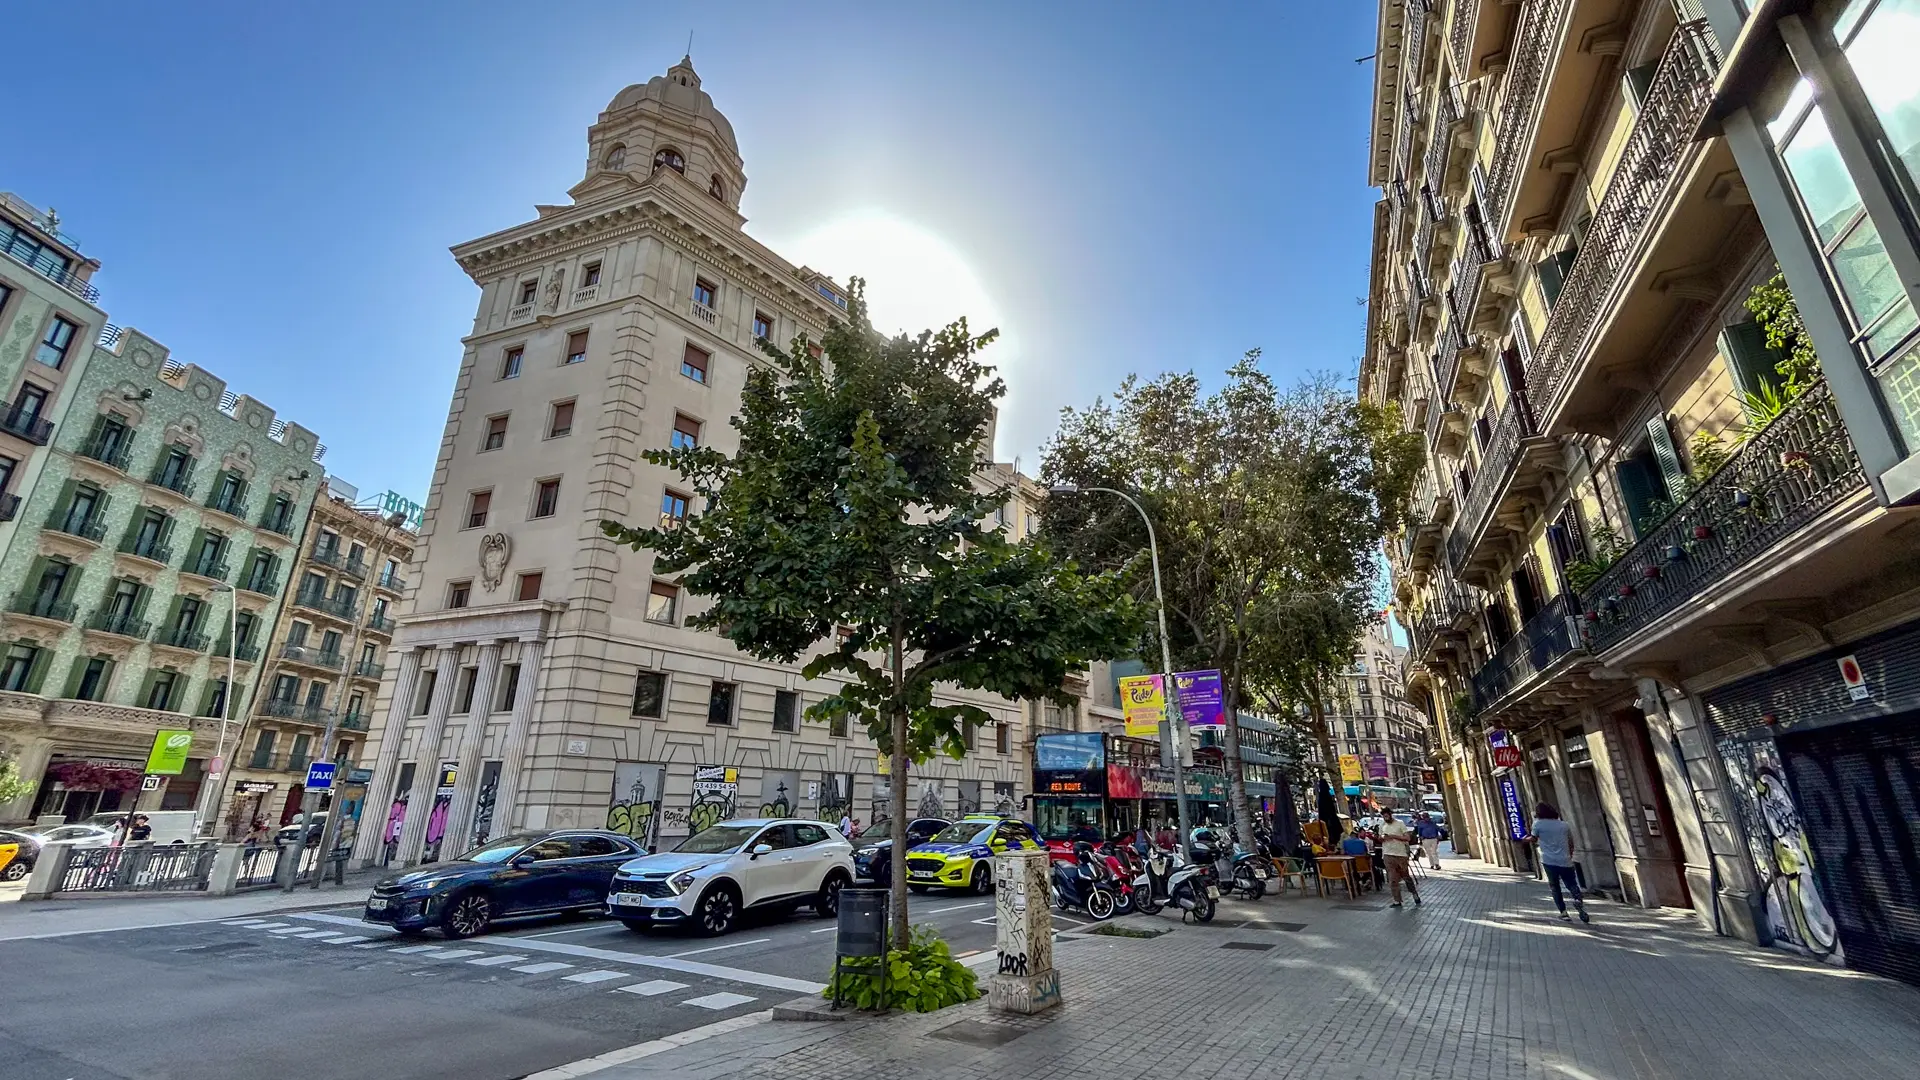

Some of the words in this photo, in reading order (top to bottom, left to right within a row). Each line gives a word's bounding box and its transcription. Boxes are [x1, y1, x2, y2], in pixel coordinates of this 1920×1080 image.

[311, 771, 333, 780] TAXI
[1050, 782, 1062, 791] RED
[1064, 782, 1082, 791] ROUTE
[1141, 776, 1174, 793] Barcelona
[1503, 781, 1522, 838] SUPERMARKET
